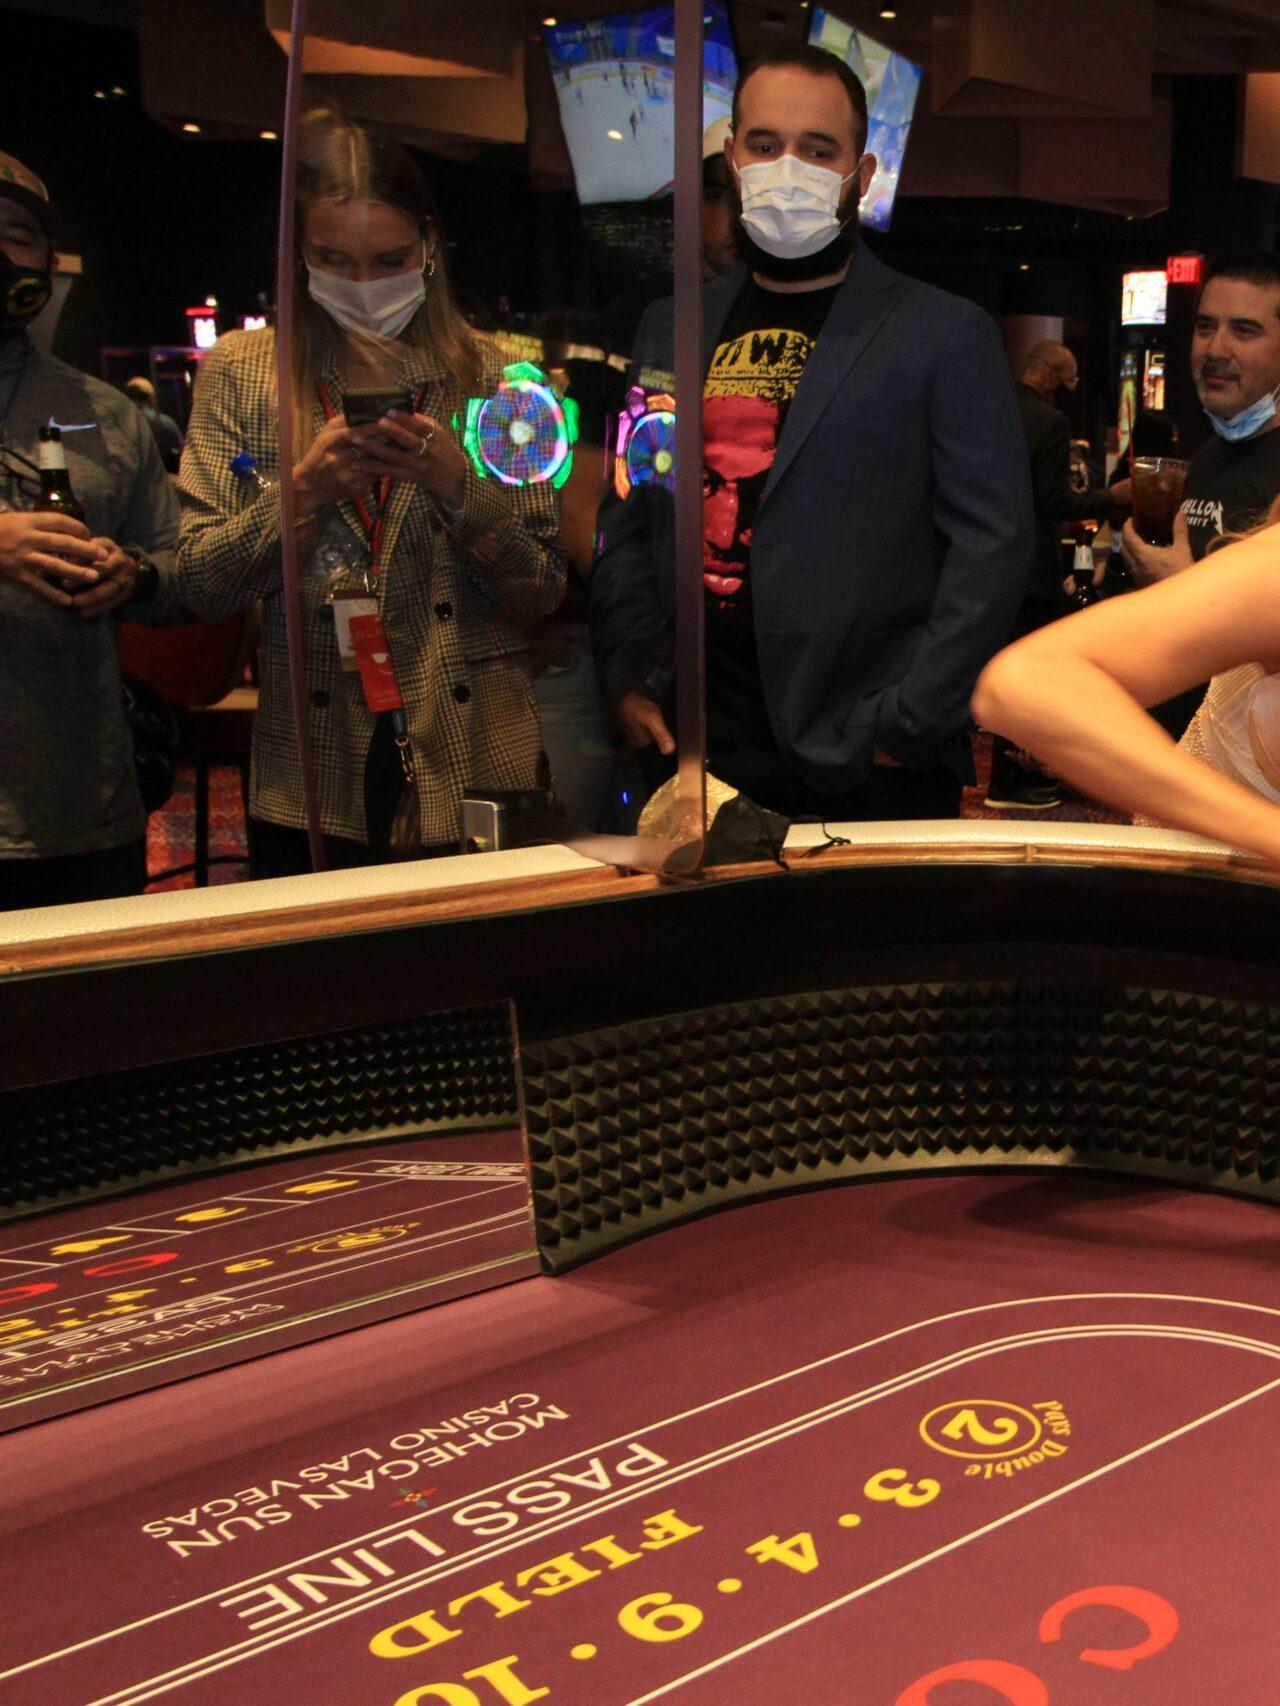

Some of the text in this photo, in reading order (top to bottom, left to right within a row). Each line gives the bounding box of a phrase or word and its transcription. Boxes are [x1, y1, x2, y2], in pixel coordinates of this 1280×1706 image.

[141, 1392, 541, 1540] CASINO LAS VEGAS
[941, 1408, 1018, 1446] 2
[964, 1399, 1071, 1481] Pays Double
[165, 1403, 571, 1559] MOHEGAN SUN
[863, 1468, 941, 1508] 3
[219, 1442, 670, 1633] PASS LINE
[746, 1532, 819, 1574] 4
[368, 1508, 704, 1660] FIELD
[617, 1592, 704, 1643] 9
